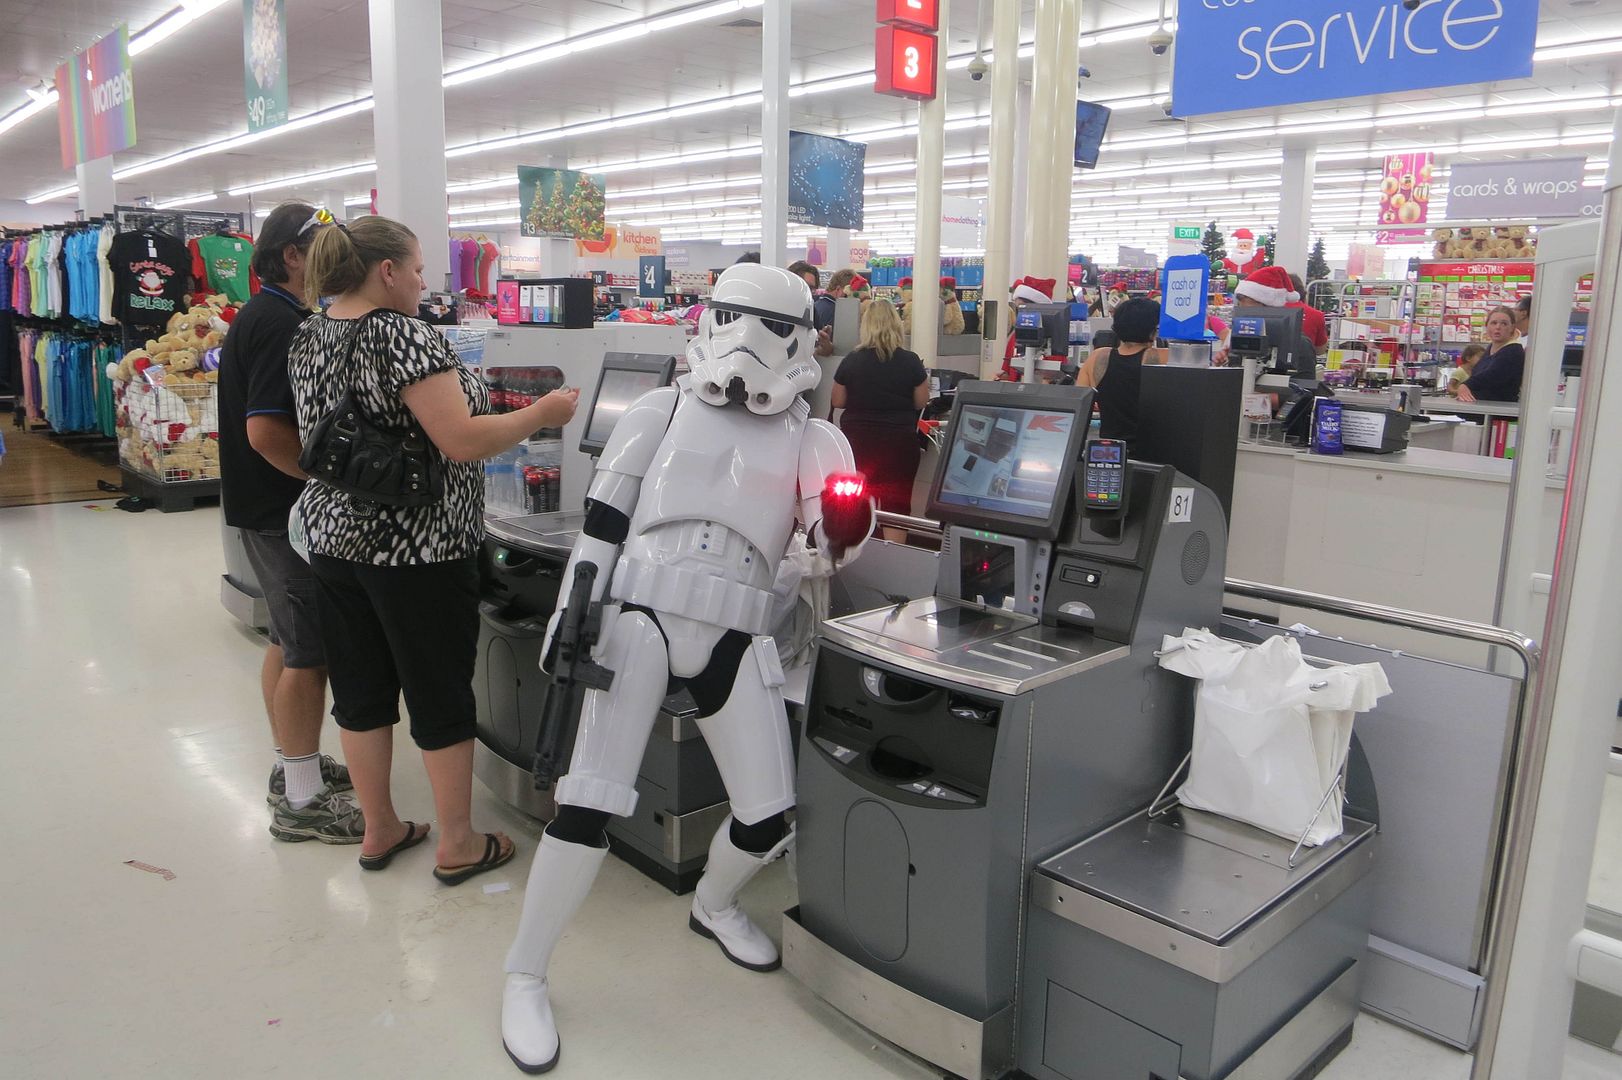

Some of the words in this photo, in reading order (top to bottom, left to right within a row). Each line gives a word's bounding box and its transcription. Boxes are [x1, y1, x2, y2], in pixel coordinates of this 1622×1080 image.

[1235, 0, 1503, 80] service
[904, 46, 919, 78] 3
[91, 68, 132, 116] womens
[248, 96, 265, 127] $49
[1453, 178, 1499, 197] cards
[1504, 177, 1518, 195] &
[1522, 180, 1578, 199] wraps
[623, 230, 657, 244] kitchen
[1179, 228, 1195, 238] EXIT
[644, 265, 656, 289] $4
[1171, 276, 1188, 290] cash
[1189, 279, 1198, 290] or
[1174, 293, 1192, 307] card
[1173, 495, 1190, 516] 81
